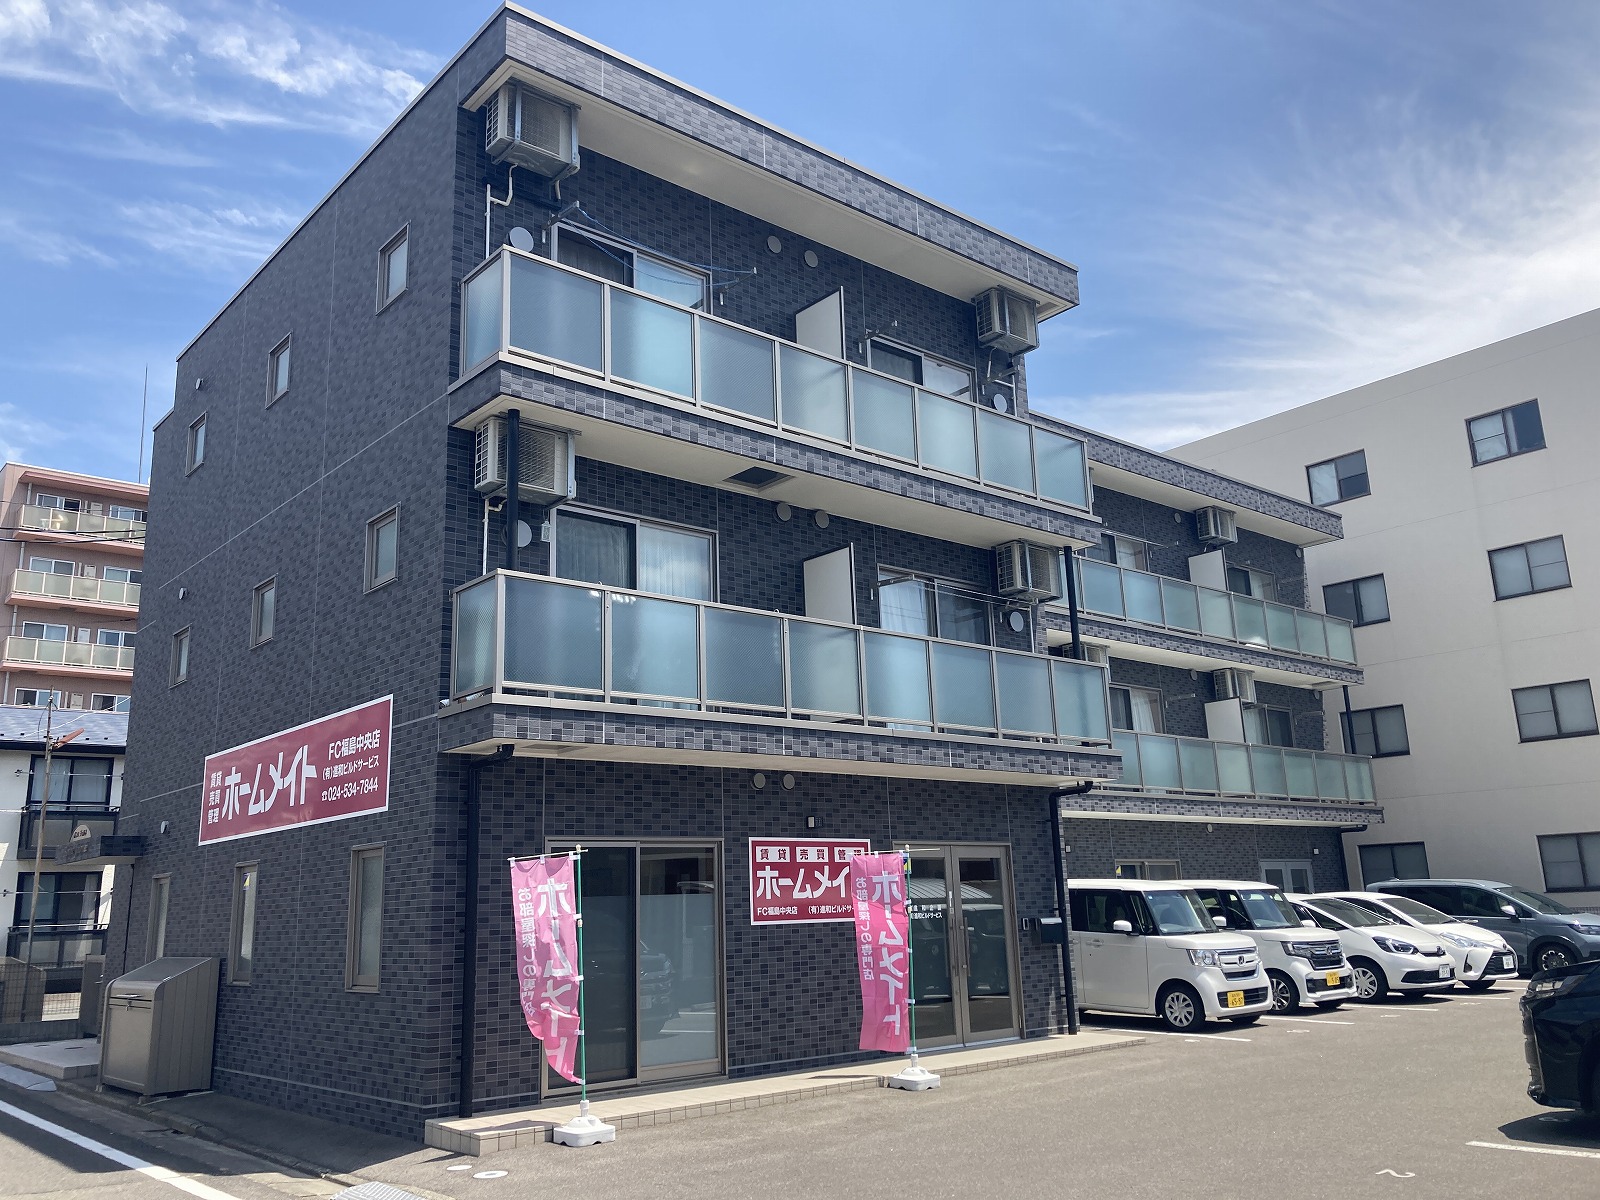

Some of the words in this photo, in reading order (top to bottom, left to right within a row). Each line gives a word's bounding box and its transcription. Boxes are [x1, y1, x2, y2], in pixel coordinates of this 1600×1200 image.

[328, 729, 381, 761] FC福島中央店
[221, 744, 318, 820] ホームメイト
[760, 848, 787, 861] 賃貸
[799, 848, 825, 860] 売買
[757, 906, 798, 916] FC福島中央店
